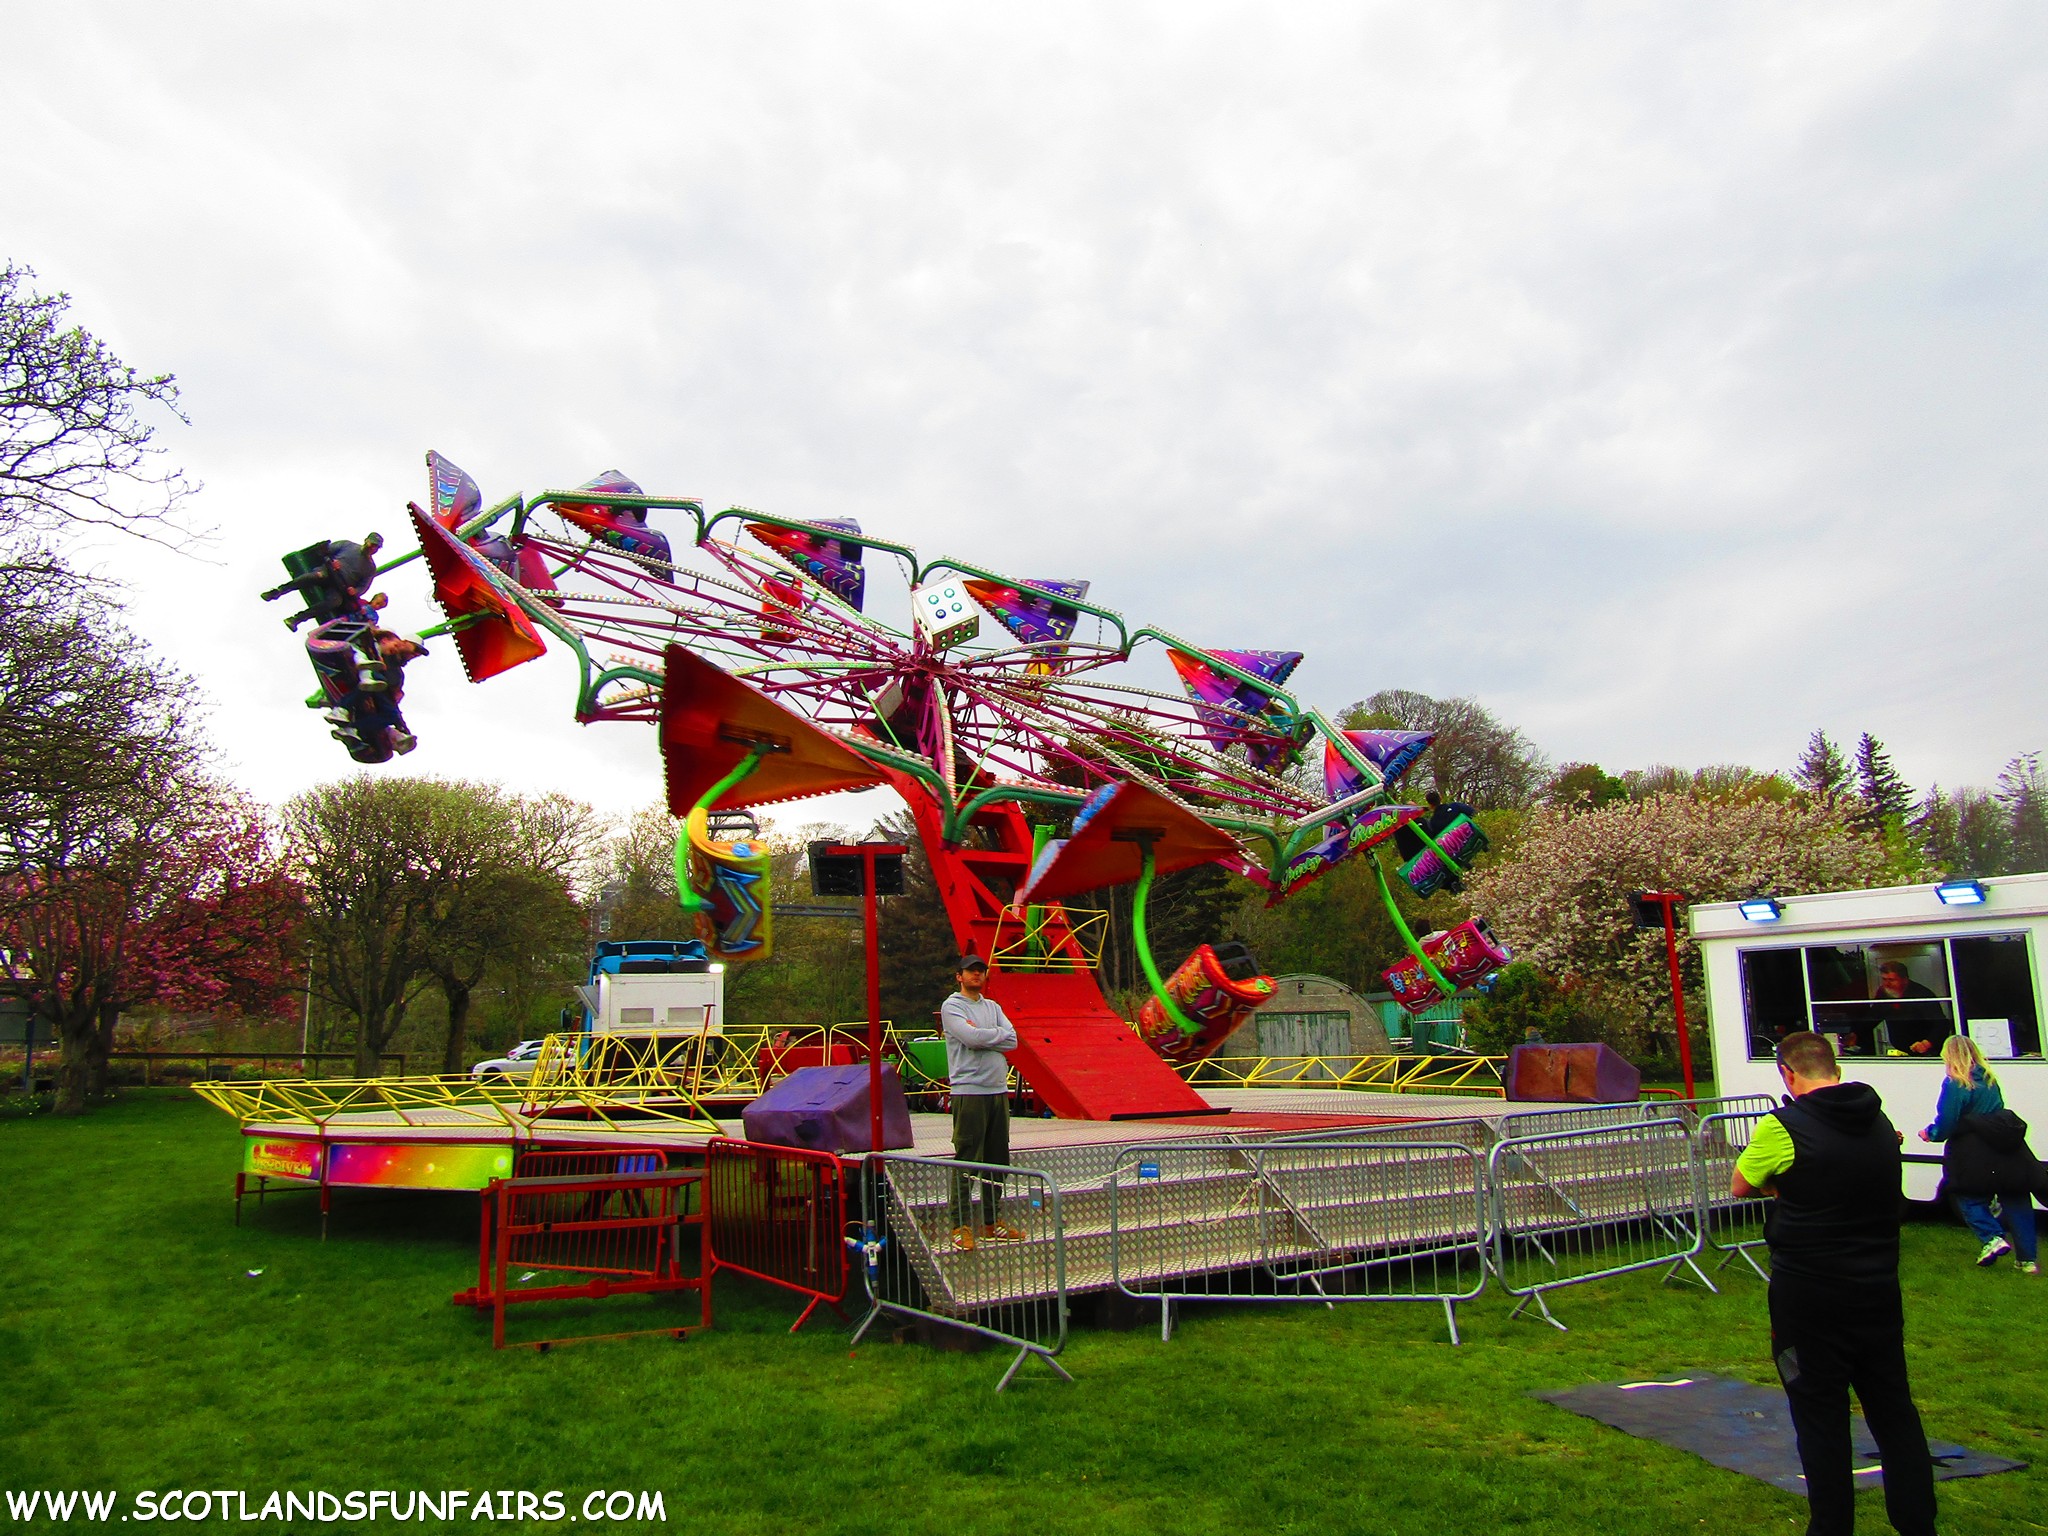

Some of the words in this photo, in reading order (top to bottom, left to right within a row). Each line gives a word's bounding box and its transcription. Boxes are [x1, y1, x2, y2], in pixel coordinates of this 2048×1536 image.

[1383, 740, 1427, 785] STYLE
[1348, 809, 1398, 849] Rock!
[1408, 848, 1442, 886] MUSI
